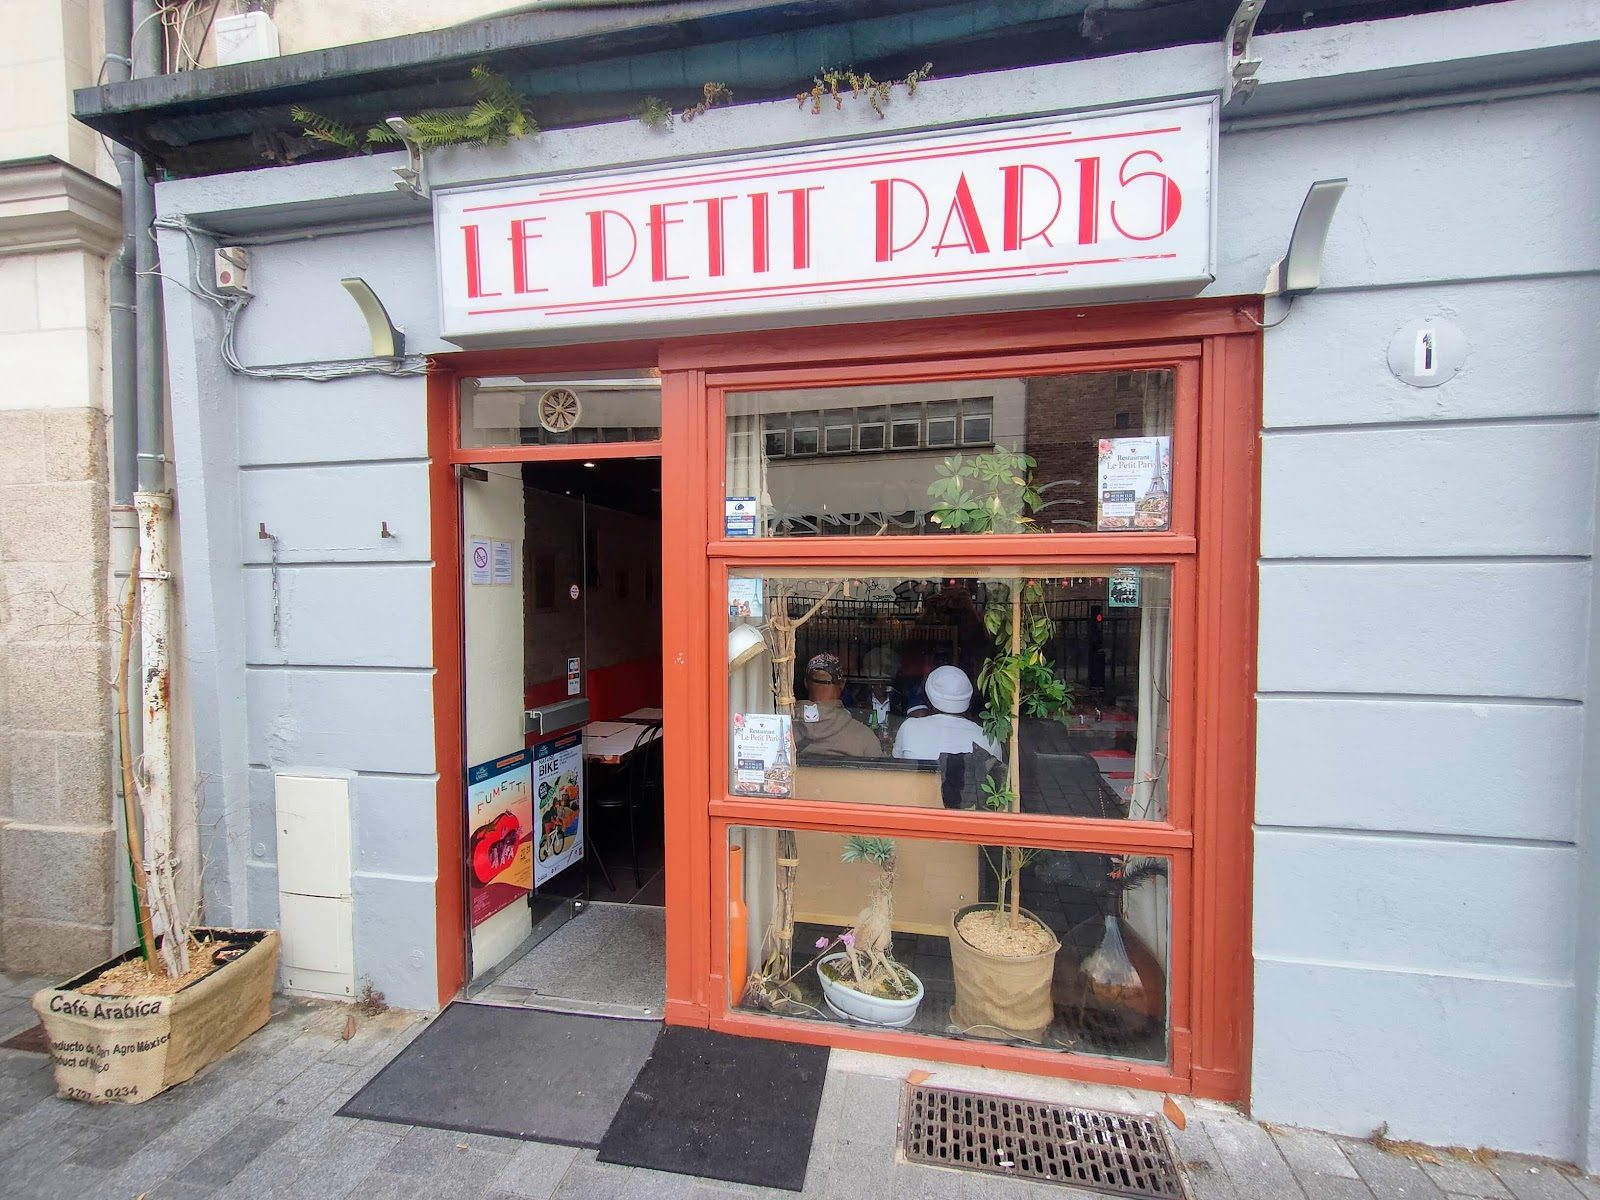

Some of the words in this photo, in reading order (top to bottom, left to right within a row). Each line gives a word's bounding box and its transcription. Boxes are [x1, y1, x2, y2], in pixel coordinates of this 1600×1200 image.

[460, 216, 549, 298] LE
[585, 185, 825, 288] PETIT
[870, 149, 1183, 263] PARIS
[1107, 462, 1117, 470] Le
[1119, 461, 1136, 469] Petit
[539, 759, 560, 778] BIKE
[49, 995, 89, 1017] Café
[93, 1001, 162, 1019] Arabica
[113, 1043, 135, 1057] Agro
[105, 1086, 138, 1098] 0234
